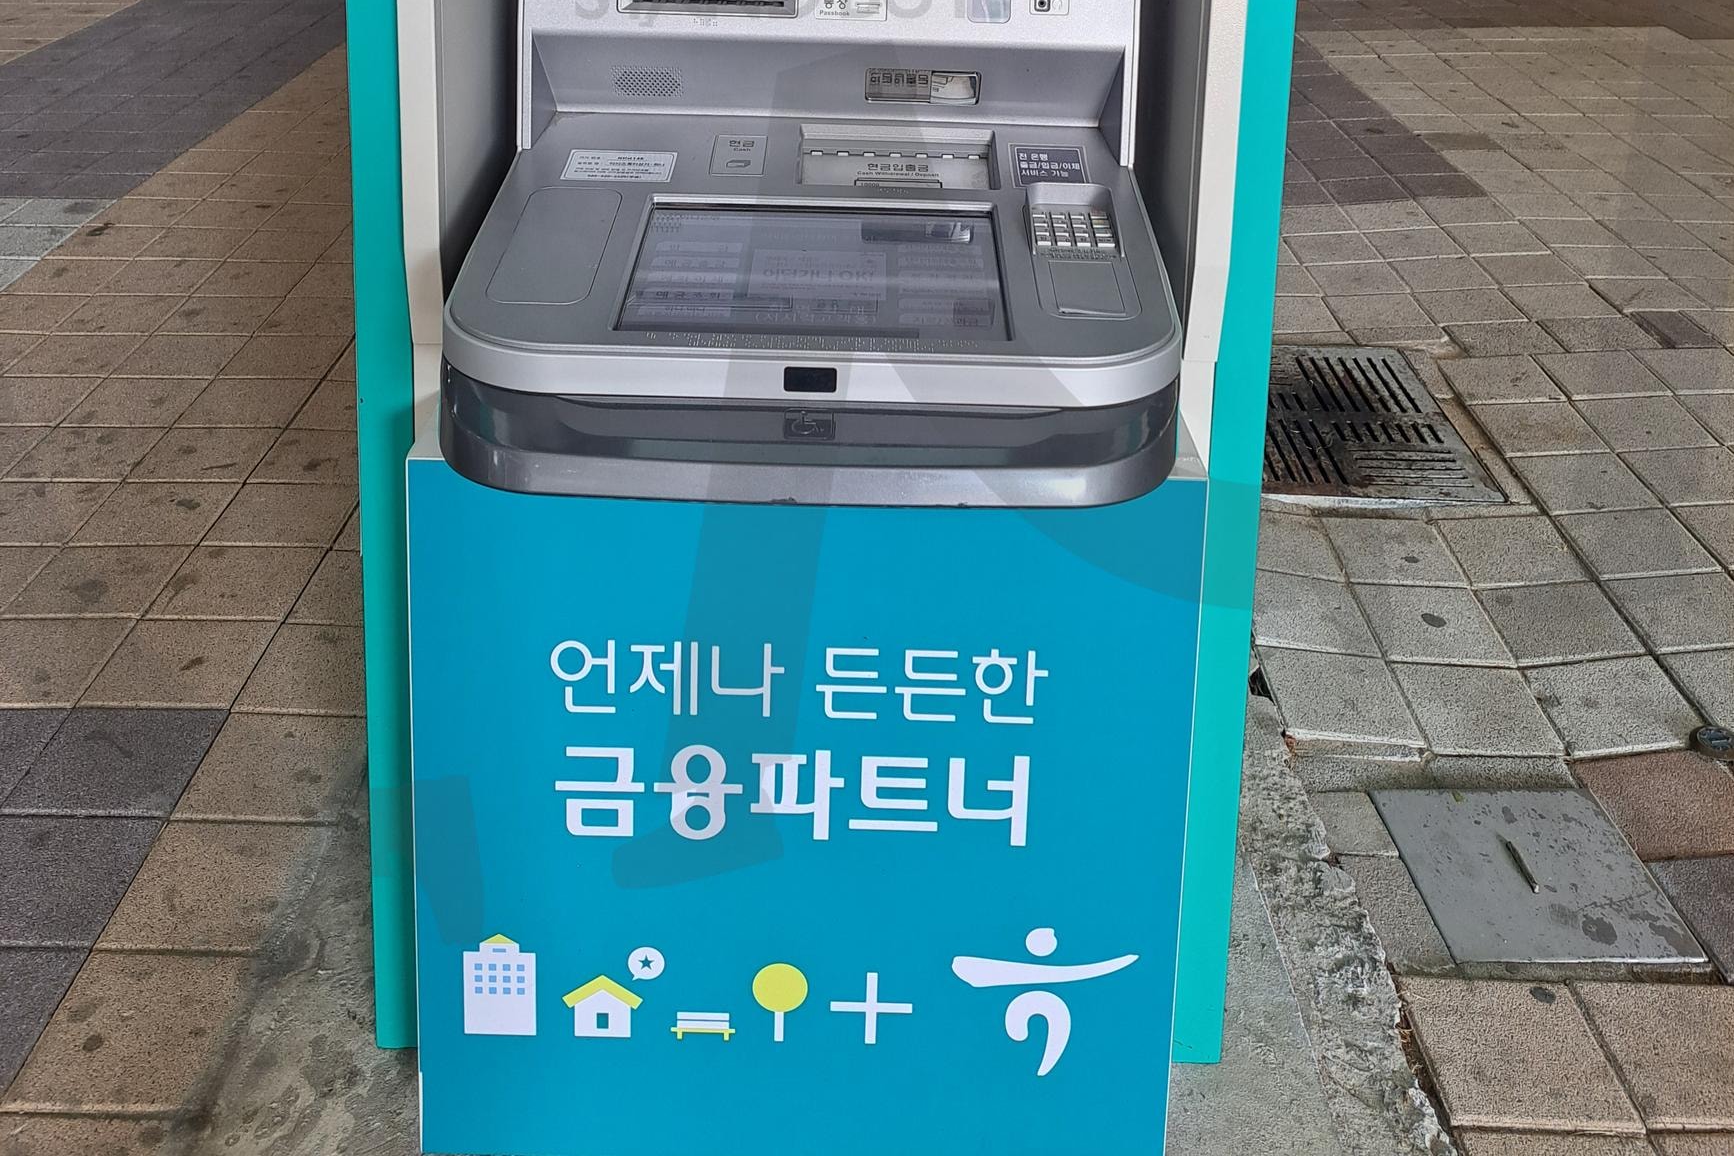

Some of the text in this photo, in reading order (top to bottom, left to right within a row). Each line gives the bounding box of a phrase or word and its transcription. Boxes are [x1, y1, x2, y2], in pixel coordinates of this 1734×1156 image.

[819, 8, 851, 17] Passbook
[729, 140, 755, 148] 현금
[1031, 153, 1048, 161] 은행
[867, 163, 929, 172] 현금입출금
[1021, 169, 1048, 177] 서비스
[550, 639, 1049, 725] 언제나 든든한
[555, 743, 1031, 847] 금융파트너
